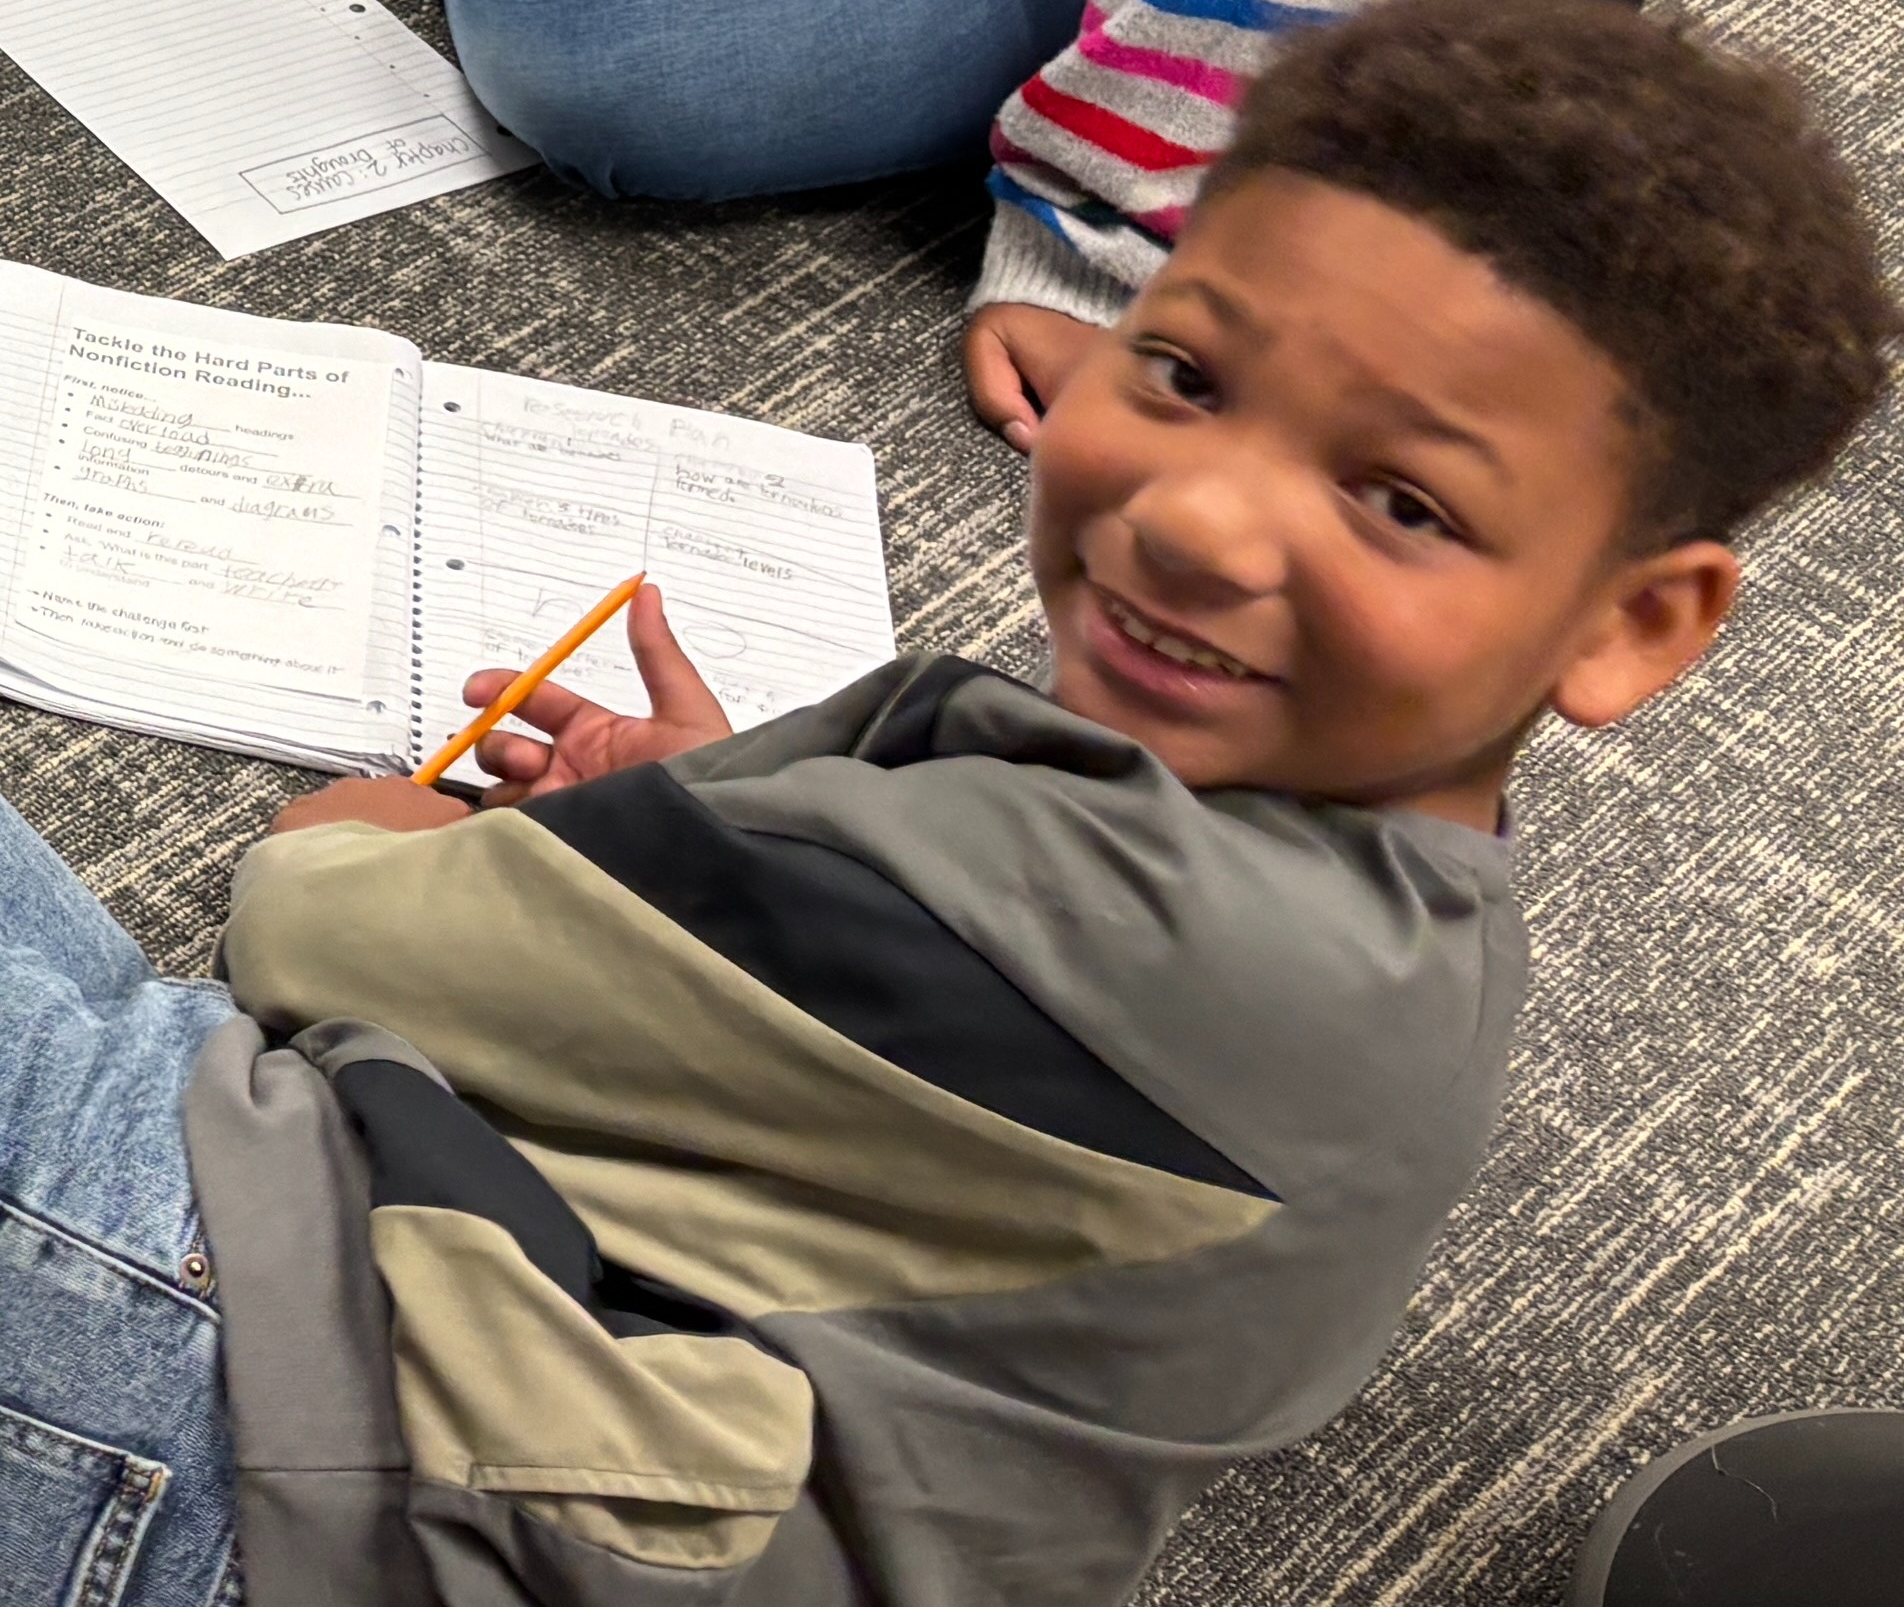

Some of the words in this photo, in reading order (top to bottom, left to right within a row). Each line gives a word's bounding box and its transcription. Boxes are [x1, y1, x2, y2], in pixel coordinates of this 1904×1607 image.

[69, 344, 185, 378] Nonfiction
[73, 327, 143, 352] Tackle
[151, 344, 186, 361] the
[194, 351, 249, 370] Hard
[257, 361, 317, 380] Parts
[325, 370, 348, 383] of
